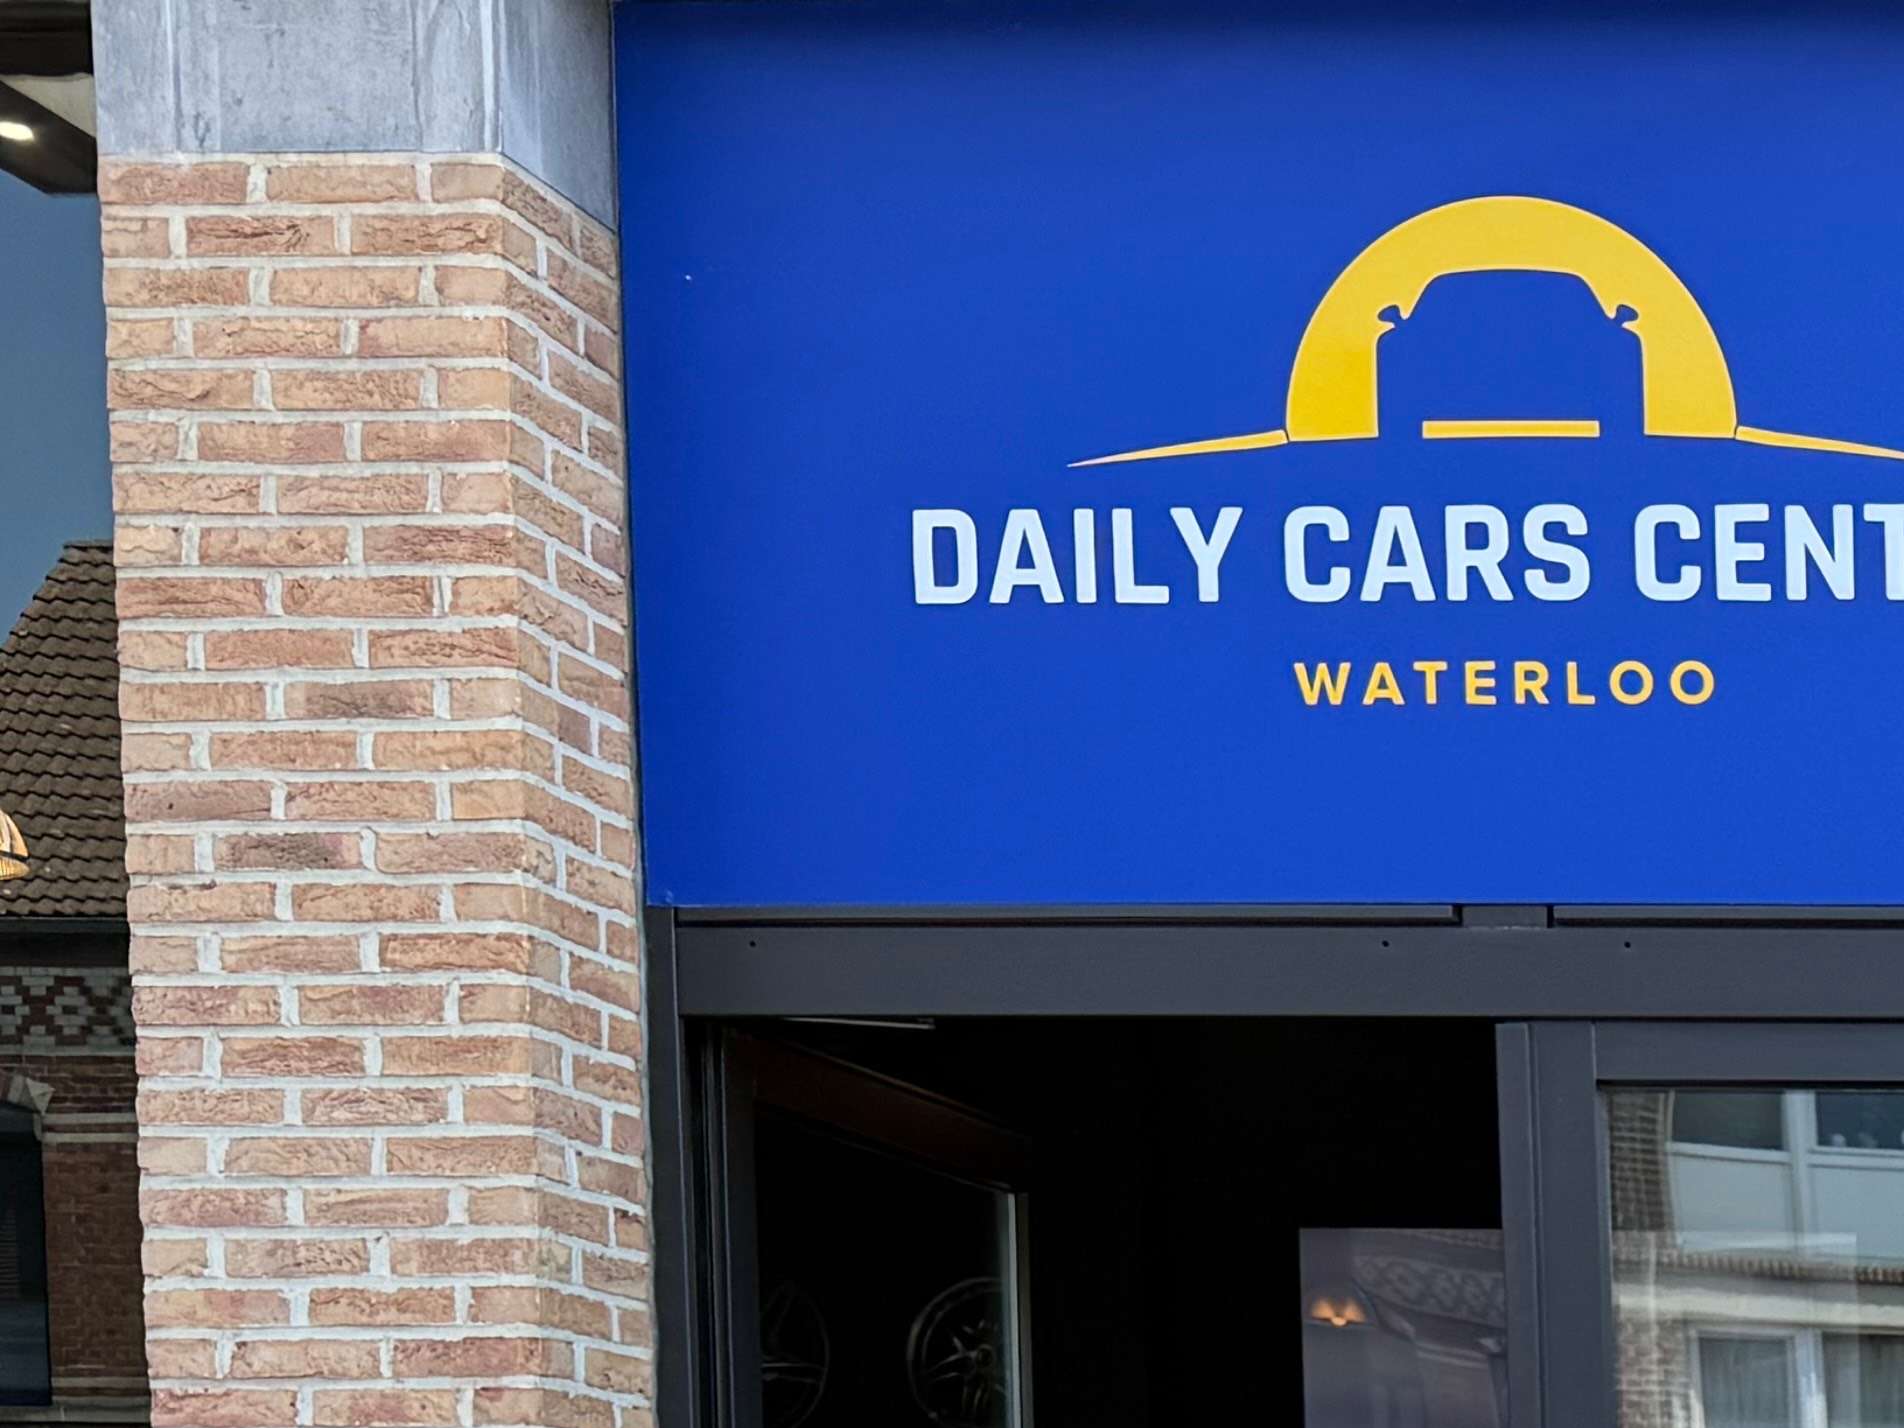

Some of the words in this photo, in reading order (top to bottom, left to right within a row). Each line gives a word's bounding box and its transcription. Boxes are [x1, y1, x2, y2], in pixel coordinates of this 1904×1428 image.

[912, 506, 1243, 605] DAILY
[1284, 503, 1592, 603] CARS
[1293, 660, 1716, 706] WATERLOO
